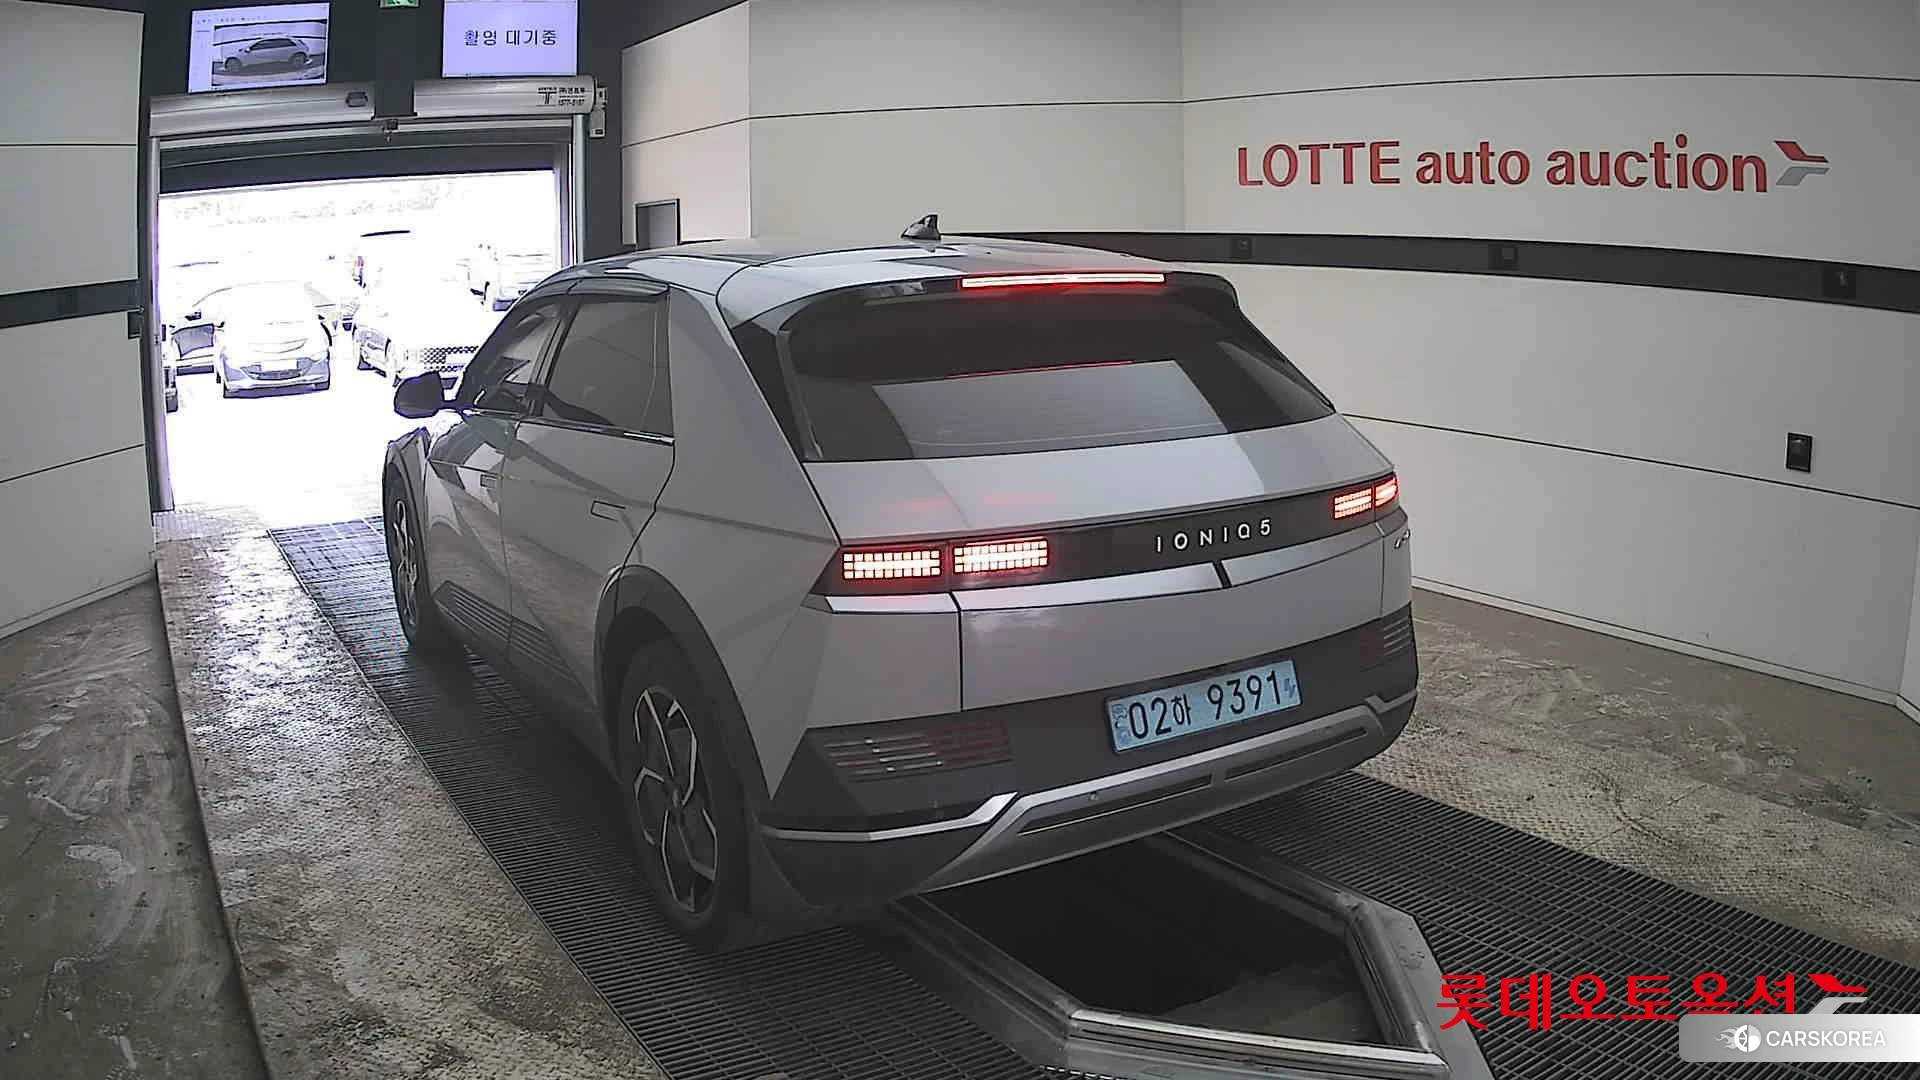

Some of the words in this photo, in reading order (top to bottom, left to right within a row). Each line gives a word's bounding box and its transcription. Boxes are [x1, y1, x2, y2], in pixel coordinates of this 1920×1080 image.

[506, 29, 557, 46] 대기중
[1237, 140, 1401, 188] LOTTE
[1415, 141, 1531, 186] auto
[1546, 133, 1768, 193] auction
[1128, 693, 1192, 740] 02하
[1207, 669, 1281, 720] 9391
